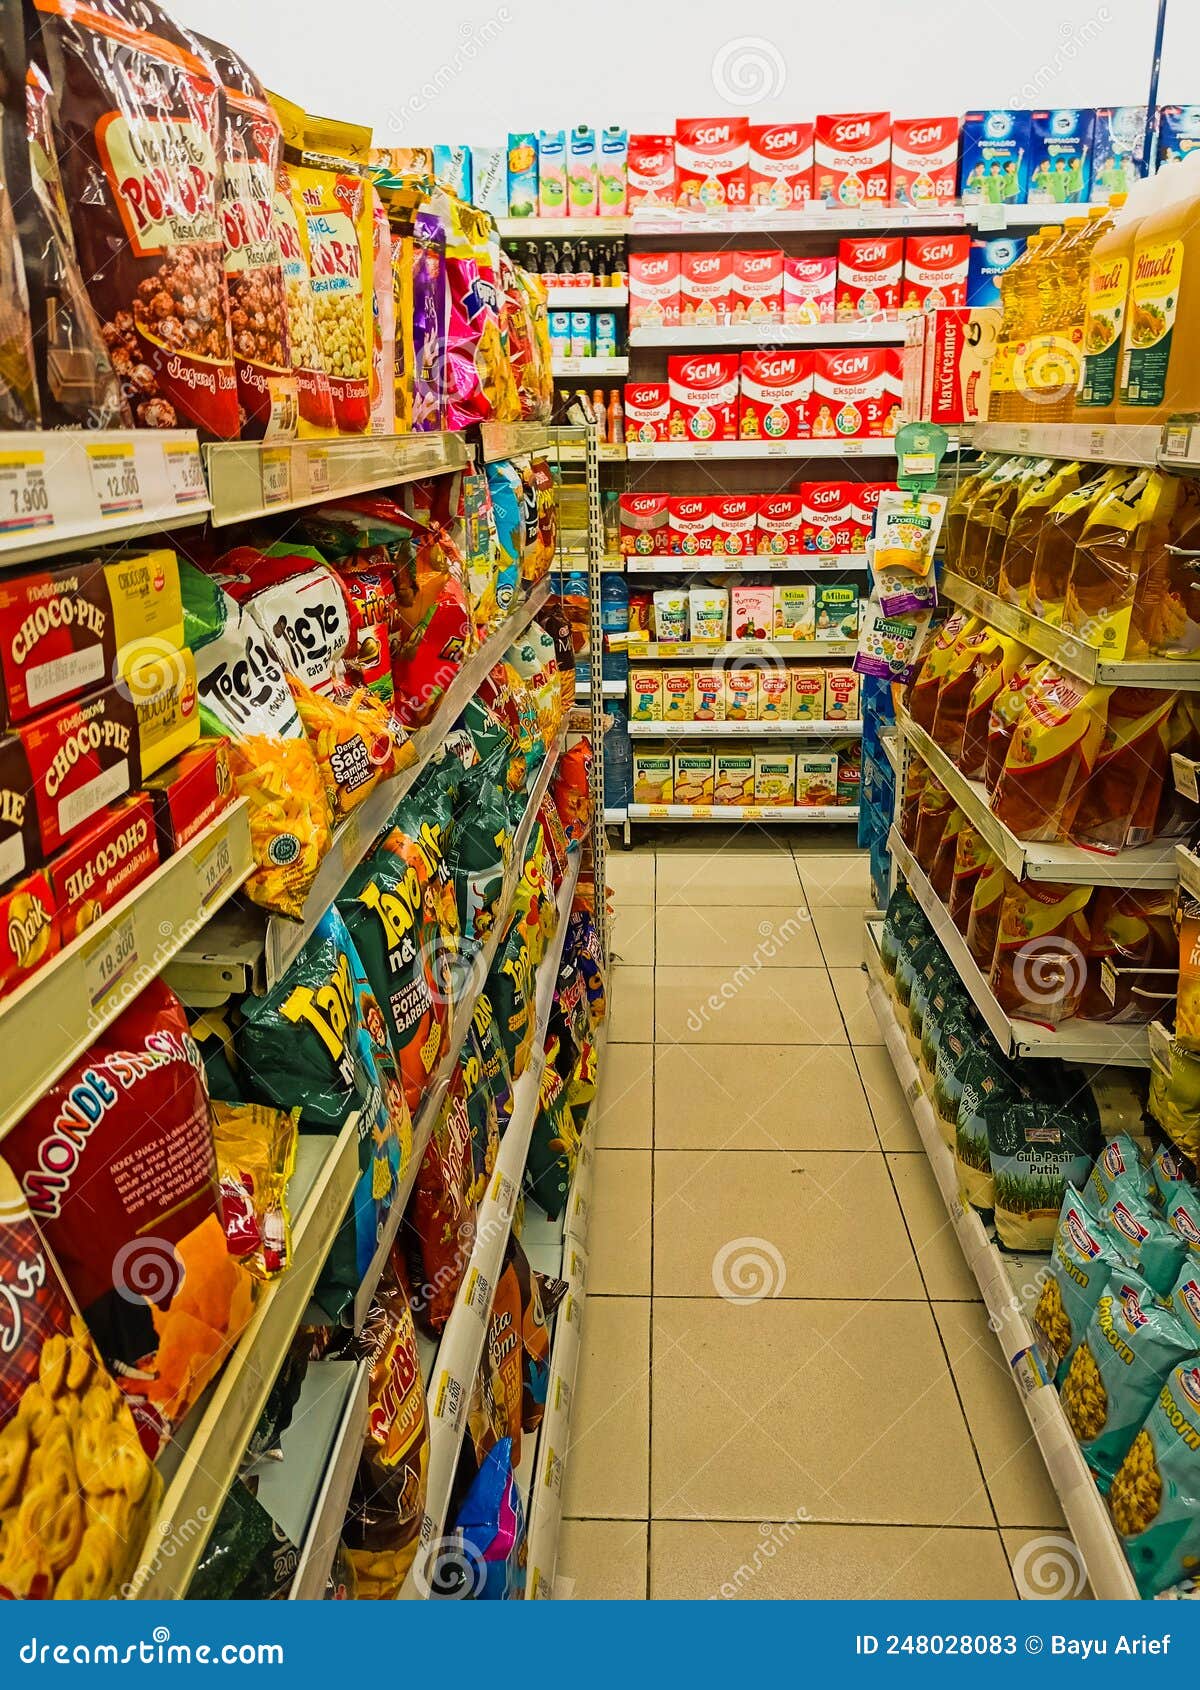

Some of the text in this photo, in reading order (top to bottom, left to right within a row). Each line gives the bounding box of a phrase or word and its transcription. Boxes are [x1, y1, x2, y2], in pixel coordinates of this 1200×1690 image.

[695, 126, 730, 146] SGM
[765, 131, 798, 150] SGM
[835, 121, 871, 143] SGM
[908, 125, 943, 146] SGM
[639, 156, 664, 170] SGM
[855, 245, 887, 264] SGM
[922, 243, 955, 262] SGM
[641, 260, 669, 276] SGM
[692, 258, 720, 274] SGM
[744, 257, 772, 273] SGM
[799, 262, 823, 276] SGM
[1135, 248, 1175, 282] Bimoli
[852, 274, 888, 283] Eksplor
[919, 272, 954, 281] Eksplor
[686, 362, 720, 381] SGM
[760, 359, 796, 378] SGM
[833, 356, 868, 376] SGM
[938, 321, 957, 411] MaxCreamer
[635, 389, 659, 403] SGM
[761, 389, 794, 398] Eksplor
[833, 387, 867, 396] Eksplor
[107, 476, 139, 498] 12.000
[10, 487, 48, 513] 7.900
[634, 499, 656, 511] SGM
[814, 490, 840, 504] SGM
[680, 502, 702, 514] SGM
[723, 502, 746, 514] SGM
[768, 502, 791, 514] SGM
[890, 515, 930, 527] Promina
[826, 592, 850, 600] Milna
[876, 619, 914, 637] Promina
[331, 743, 367, 772] Saos
[720, 760, 750, 768] Promina
[335, 755, 369, 783] Sambal
[359, 867, 421, 950] Taro
[9, 896, 51, 967] Dark
[99, 932, 135, 981] 19.300
[23, 1069, 117, 1218] MONDE
[1016, 1151, 1075, 1163] Gula Pasir
[1029, 1164, 1060, 1175] Putih
